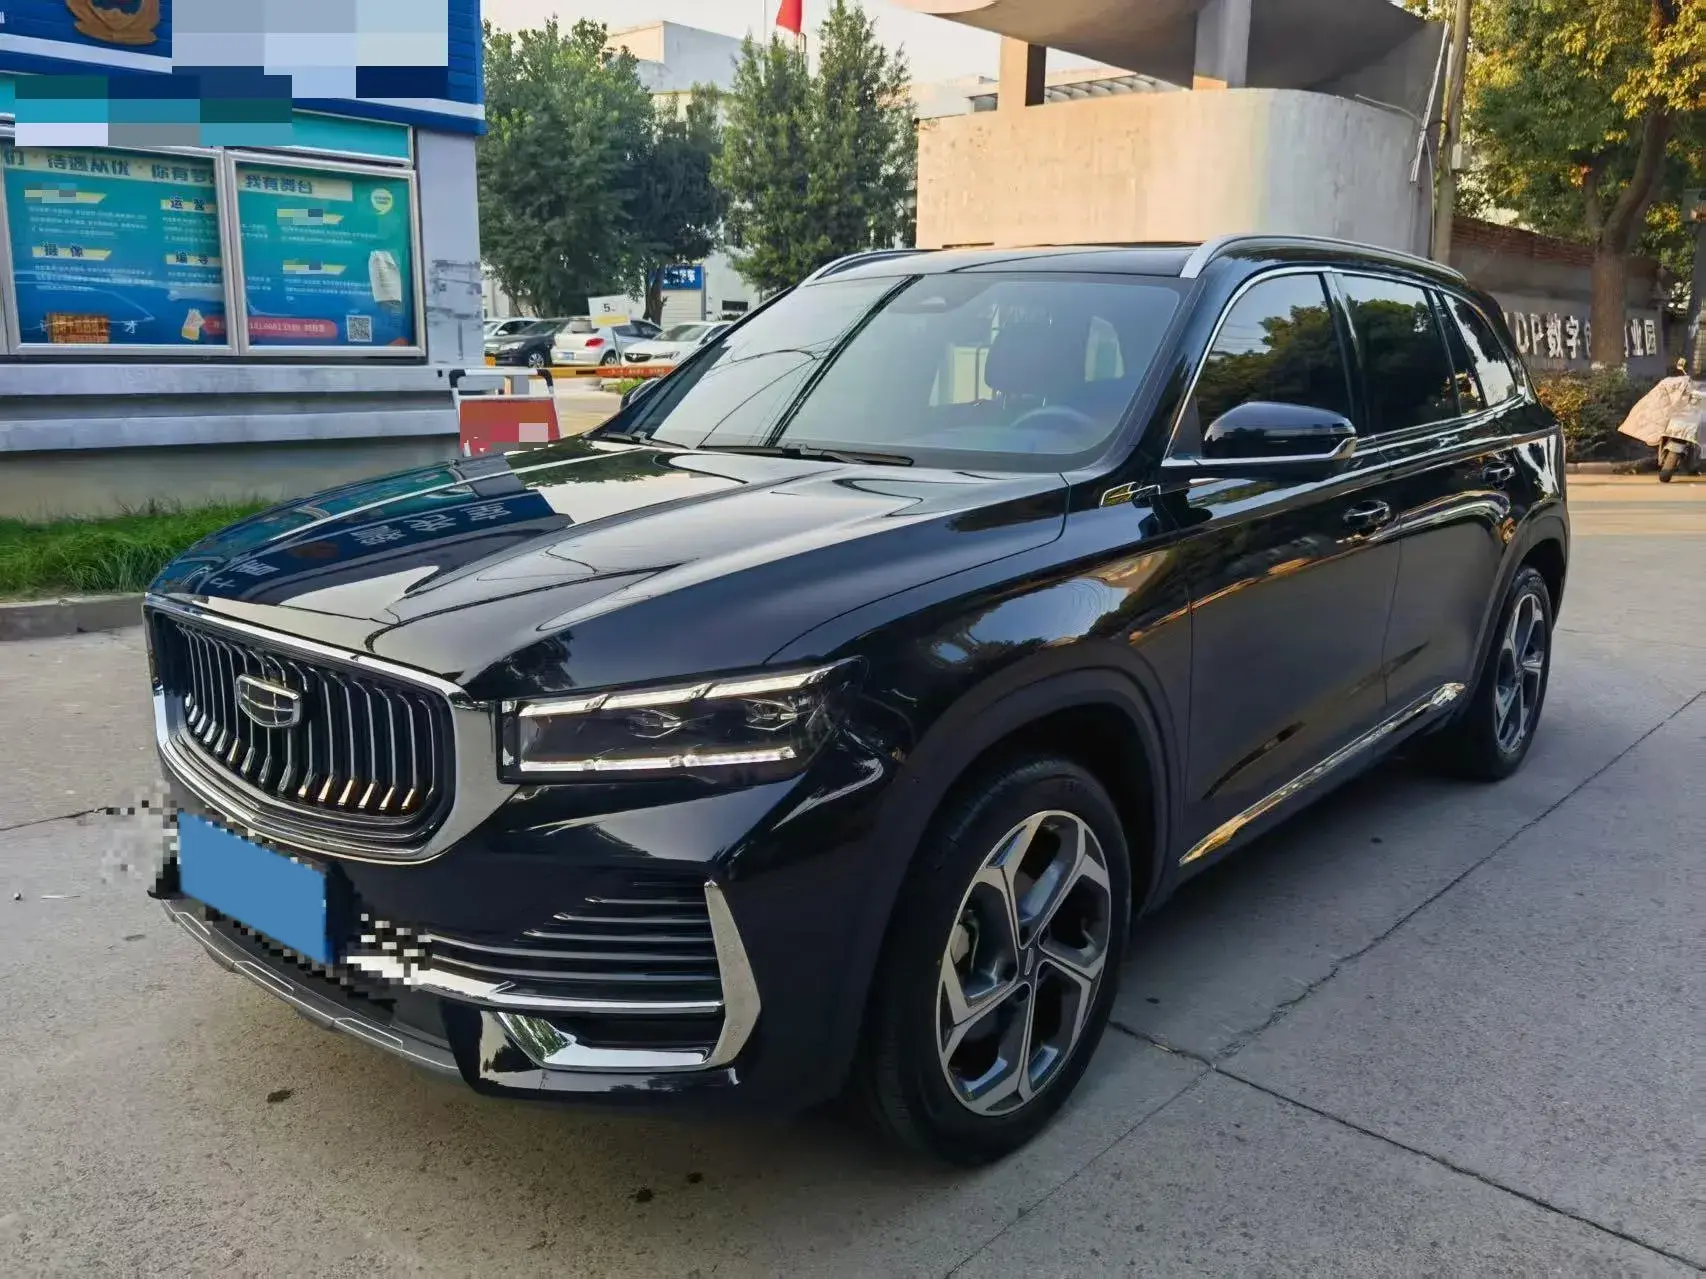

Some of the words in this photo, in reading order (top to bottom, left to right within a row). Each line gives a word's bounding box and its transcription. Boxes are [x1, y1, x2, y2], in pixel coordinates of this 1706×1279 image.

[48, 154, 130, 176] 待遇从优
[246, 174, 313, 194] 我有舞台
[603, 303, 611, 313] 5
